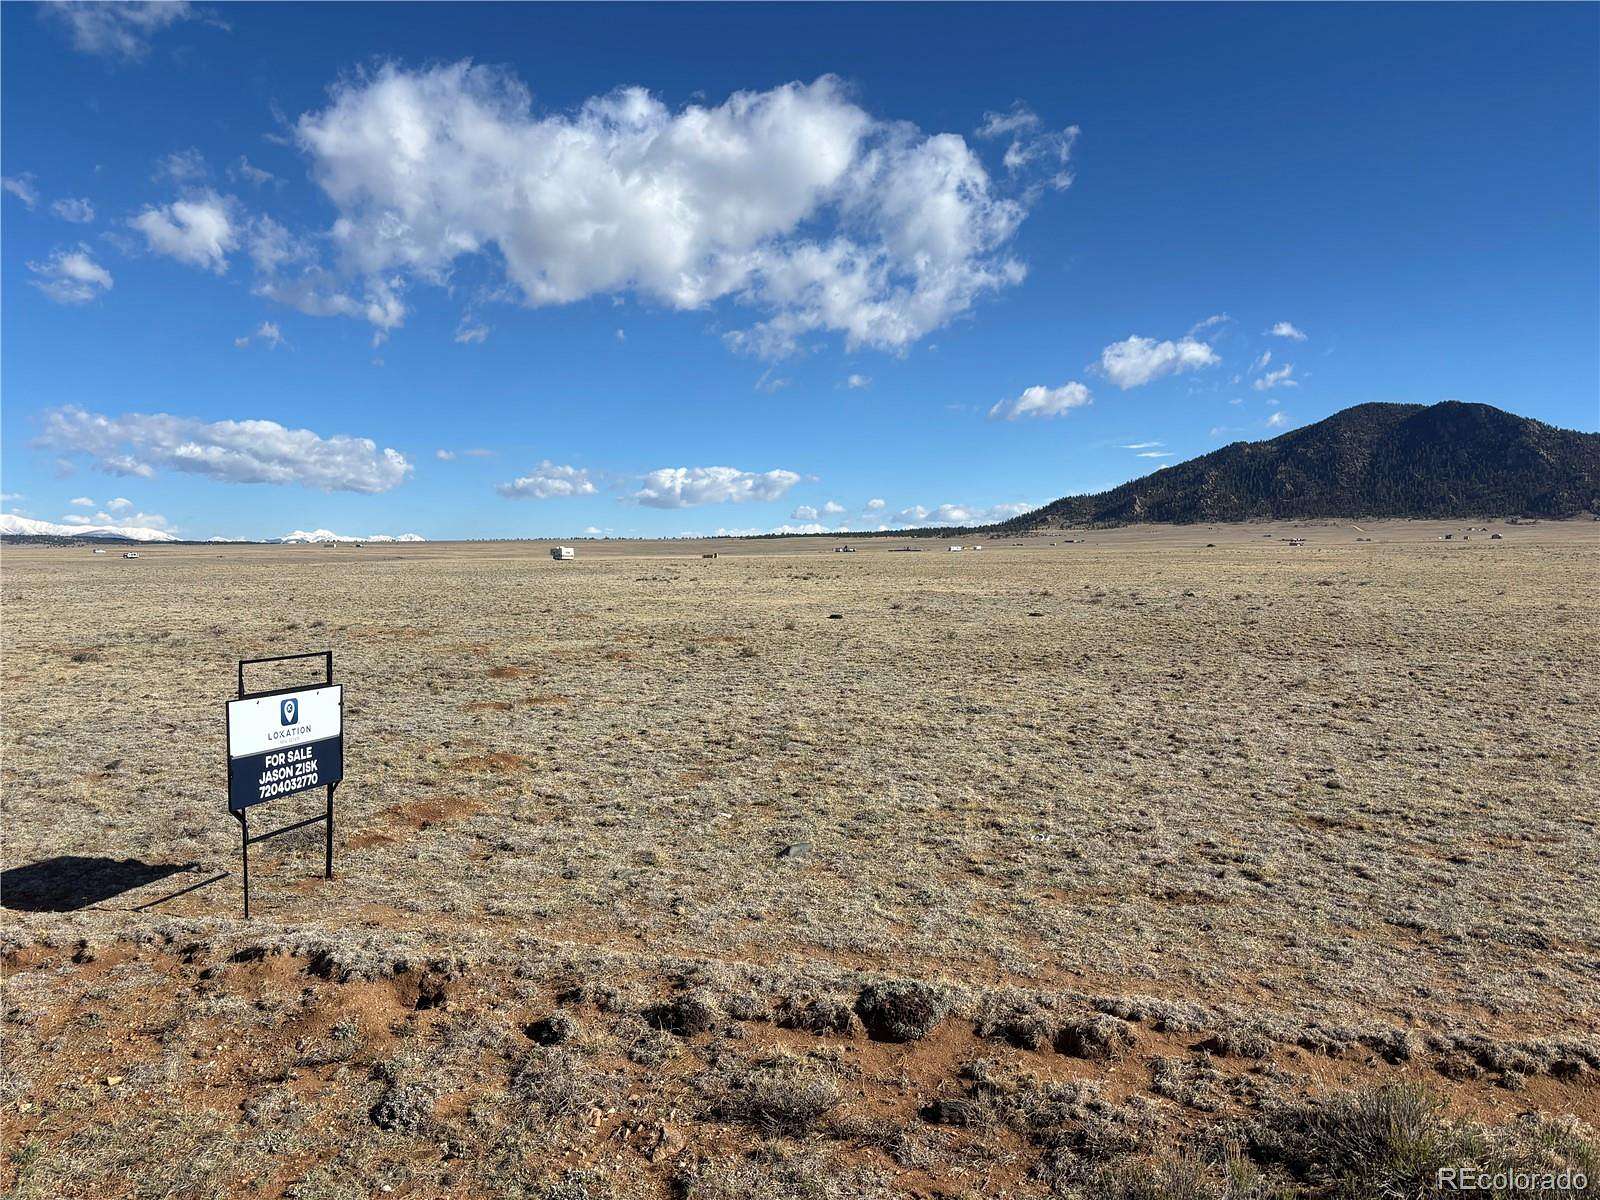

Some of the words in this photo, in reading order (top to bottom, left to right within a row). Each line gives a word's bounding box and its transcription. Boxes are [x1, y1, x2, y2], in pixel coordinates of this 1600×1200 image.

[267, 724, 312, 741] LOKATION
[265, 753, 286, 768] FOR
[287, 746, 313, 763] SALE
[258, 765, 294, 785] JASON
[295, 759, 318, 776] ZISK
[258, 772, 319, 799] 7204032770
